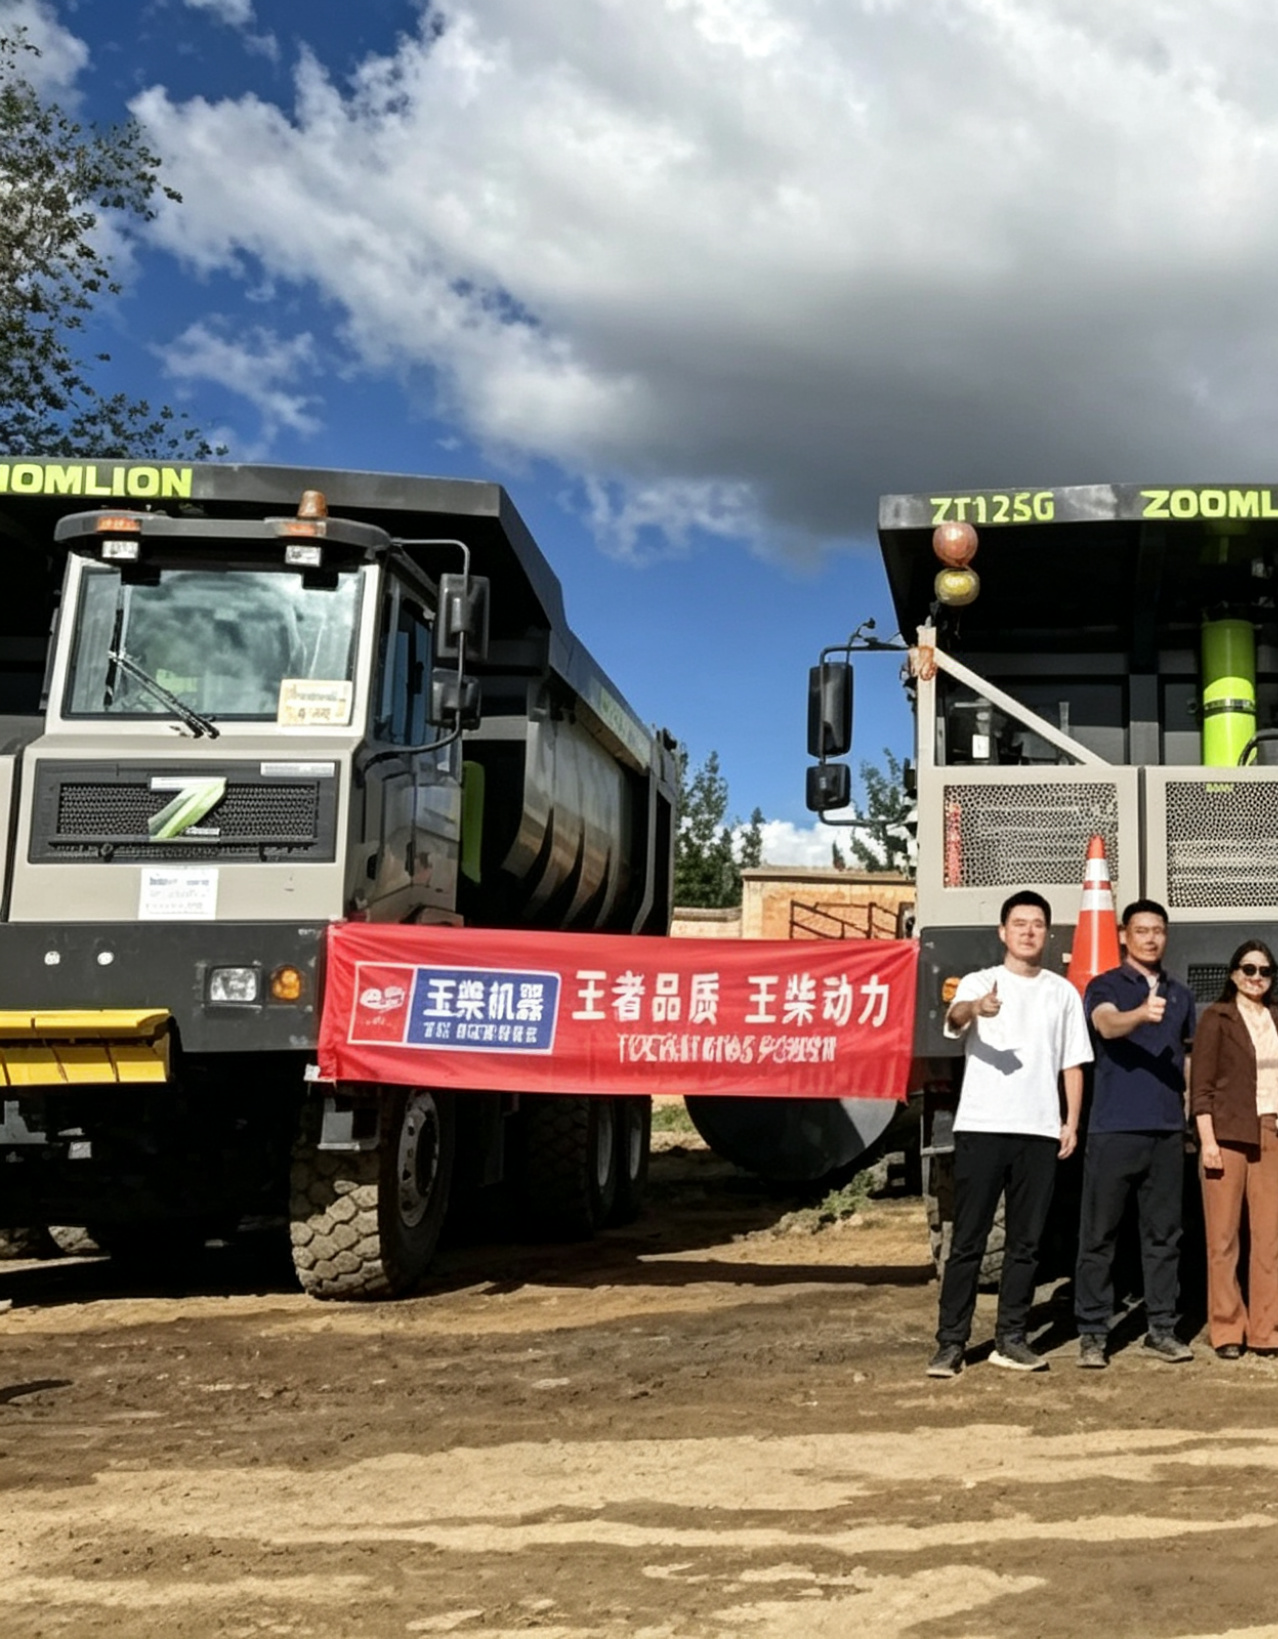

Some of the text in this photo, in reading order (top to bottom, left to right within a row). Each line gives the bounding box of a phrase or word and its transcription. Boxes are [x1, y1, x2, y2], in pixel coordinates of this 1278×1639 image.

[0, 464, 192, 497] OMLION
[572, 970, 720, 1025] 王者品质
